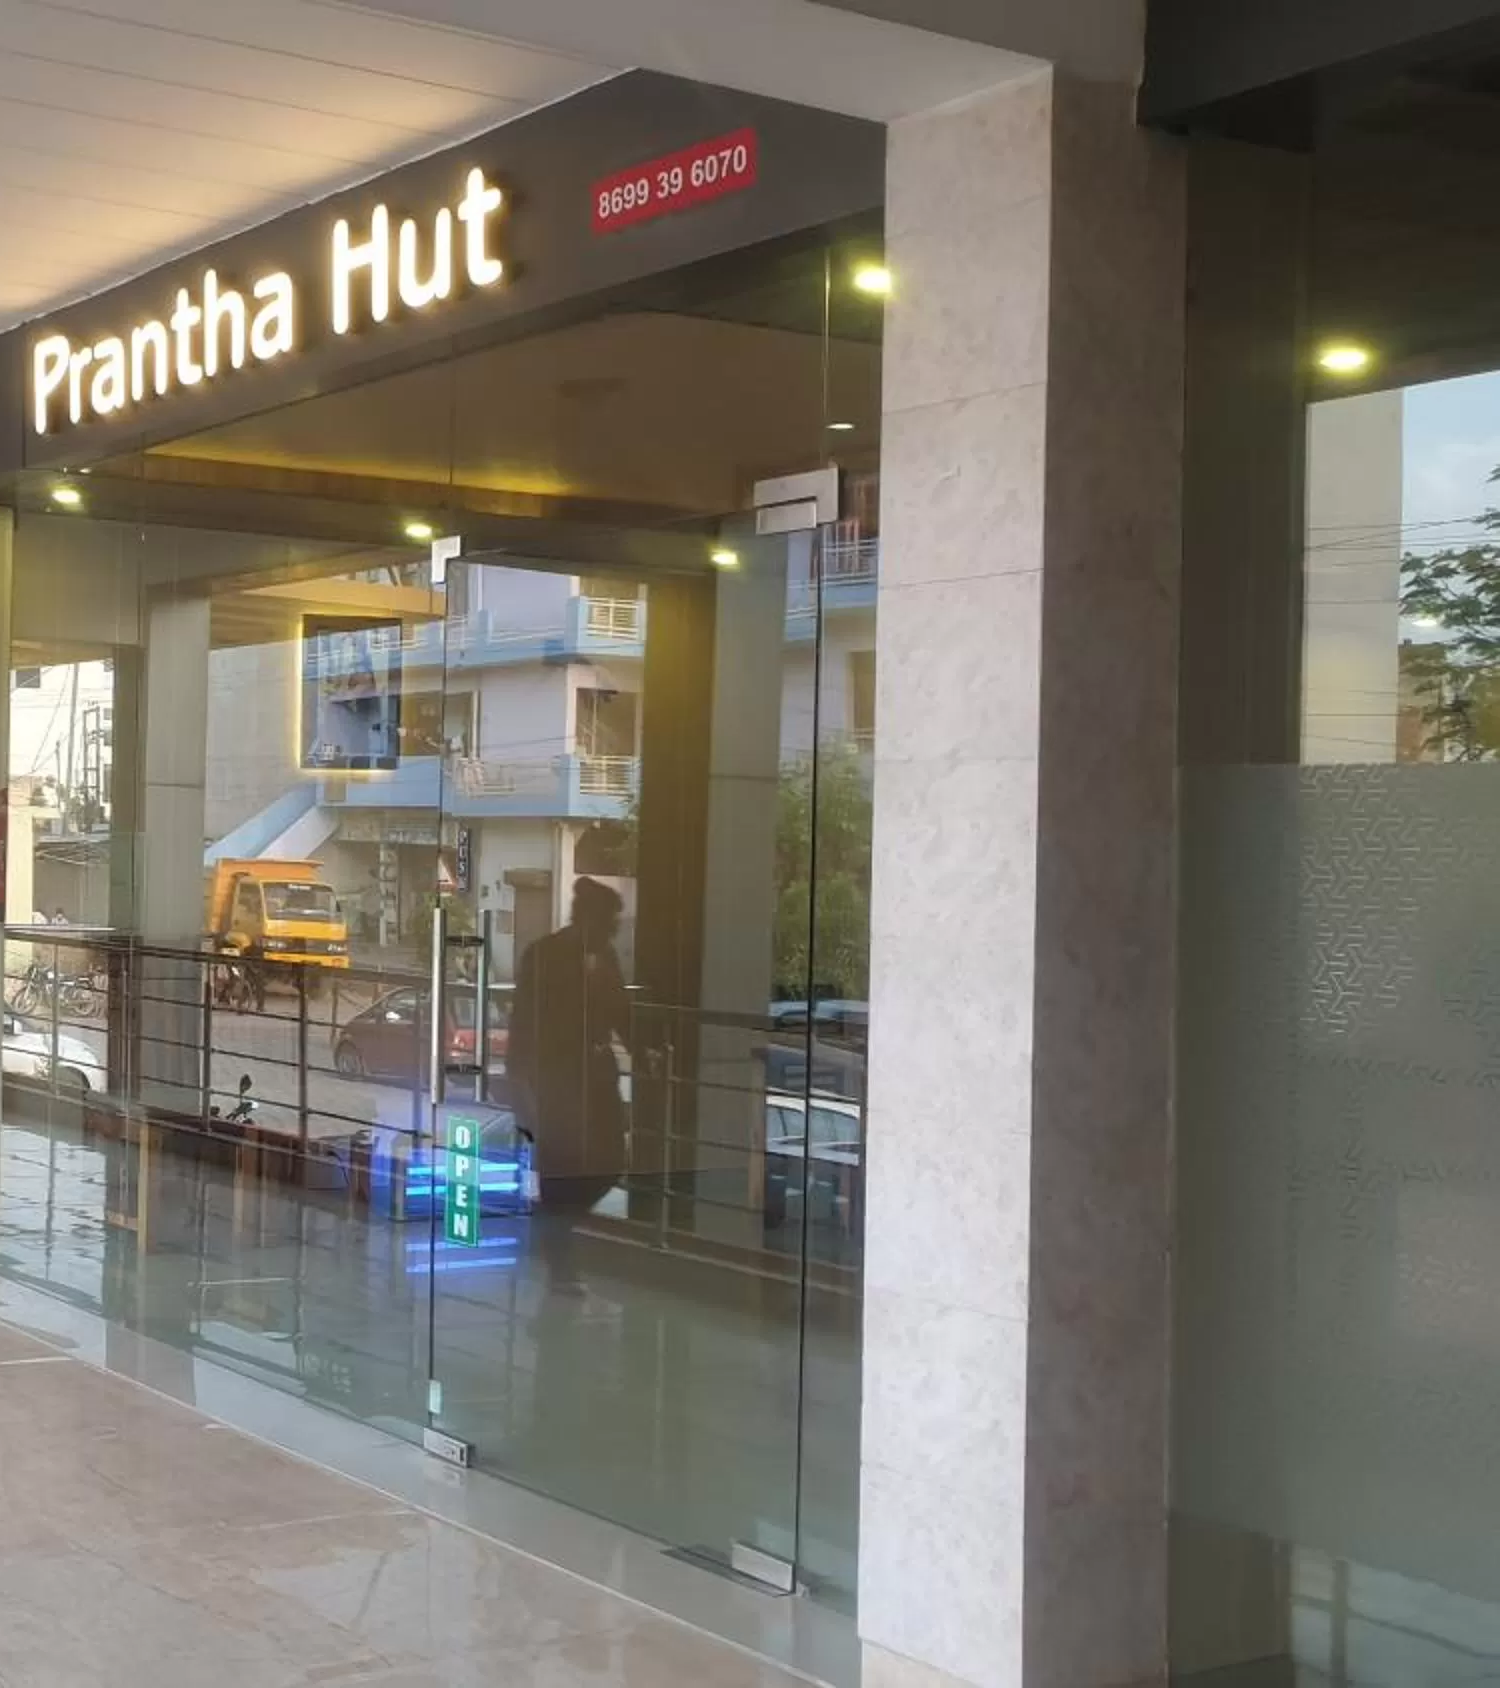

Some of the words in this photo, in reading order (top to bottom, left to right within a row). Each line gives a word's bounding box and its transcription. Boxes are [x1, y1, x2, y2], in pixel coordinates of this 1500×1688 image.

[598, 176, 650, 220] 8699
[655, 166, 684, 199] 39
[689, 144, 748, 188] 6070
[31, 268, 294, 435] Prantha
[330, 165, 504, 335] Hut
[453, 1125, 471, 1238] OPEN
